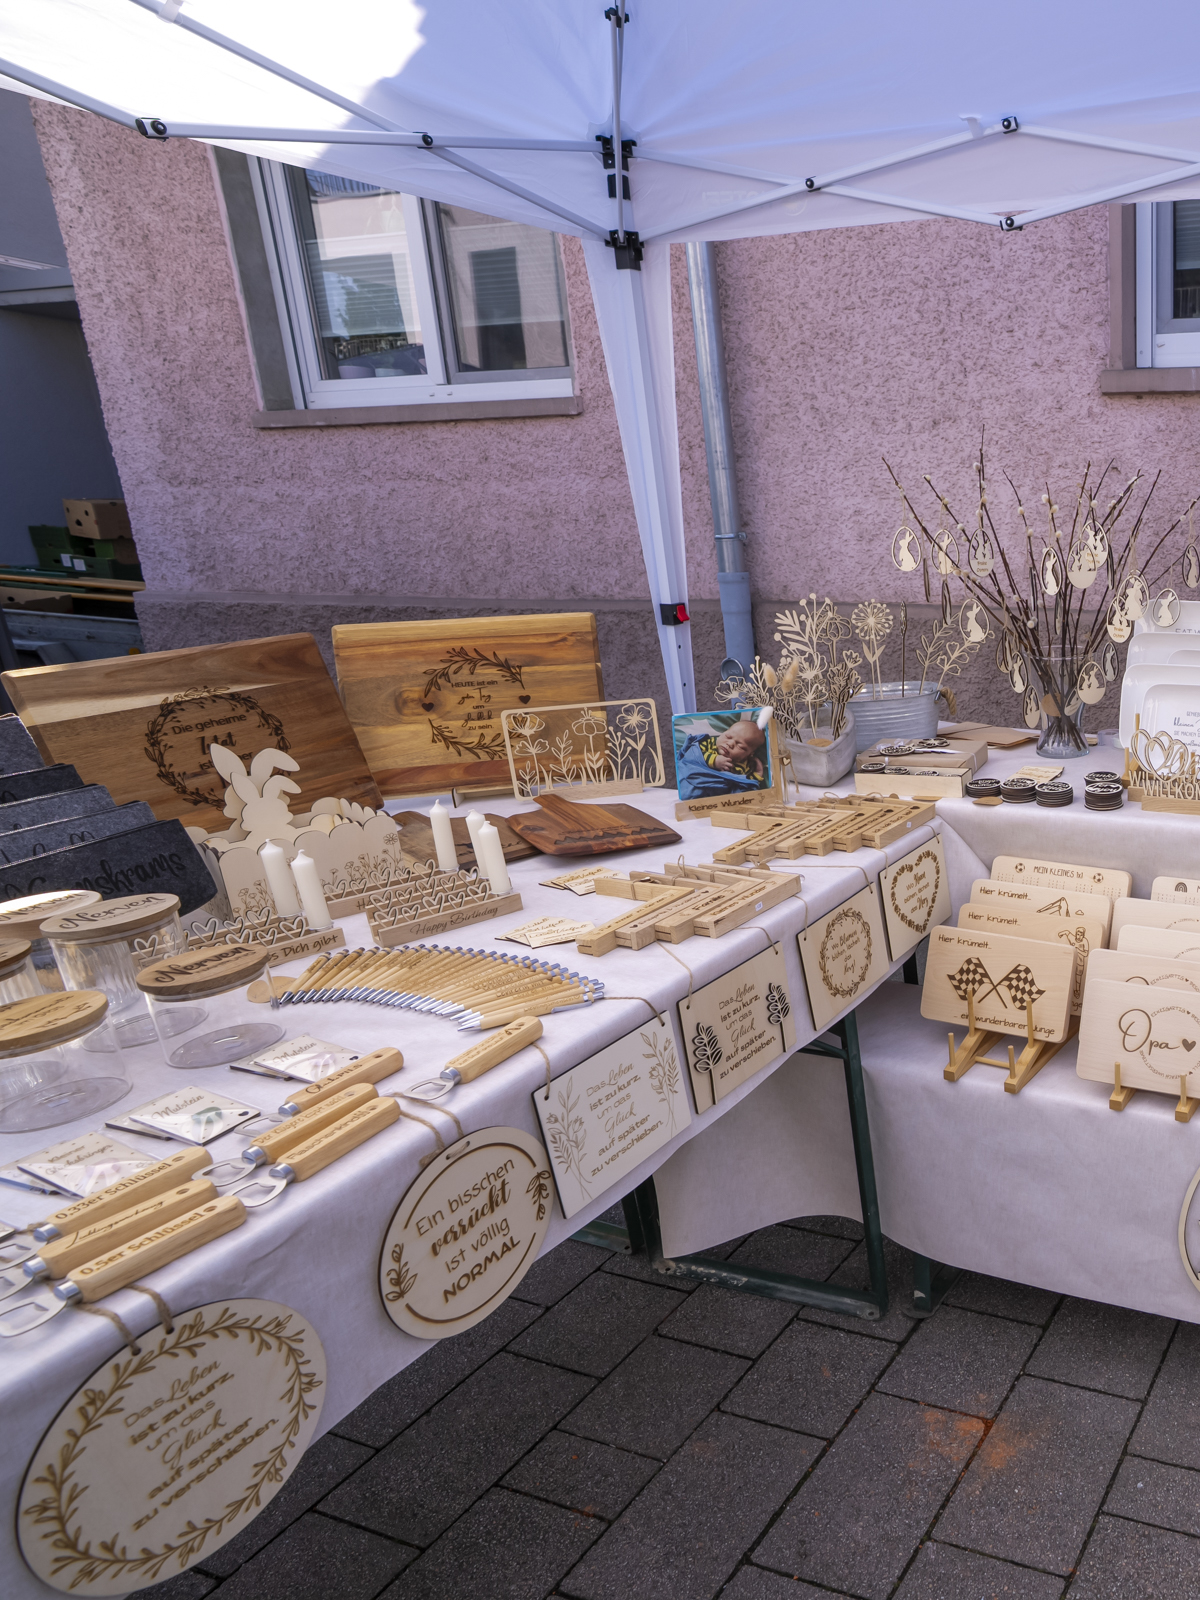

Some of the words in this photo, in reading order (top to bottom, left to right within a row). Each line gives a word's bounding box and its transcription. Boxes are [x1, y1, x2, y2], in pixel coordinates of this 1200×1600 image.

[451, 681, 476, 689] HEUTE
[171, 723, 194, 736] Die
[195, 712, 248, 733] geheime
[688, 801, 718, 812] Kleines
[720, 796, 755, 809] Wunder
[1033, 866, 1049, 875] MEIN
[1050, 868, 1075, 879] KLEINES
[979, 886, 995, 897] Hier
[58, 895, 167, 931] Nerven
[410, 918, 450, 936] Happy
[450, 906, 499, 925] Birthday
[968, 911, 984, 921] Hier
[280, 943, 309, 958] Dich
[312, 934, 339, 953] gibt
[938, 934, 955, 944] Hier
[154, 946, 257, 984] Nerven
[718, 997, 734, 1011] Das
[733, 983, 756, 1004] Leben
[720, 1011, 732, 1023] ist
[732, 1004, 742, 1016] zu
[725, 1017, 739, 1031] um
[739, 1009, 753, 1023] das
[730, 1017, 757, 1048] Glück
[975, 1014, 1028, 1031] wunderbarer
[1033, 1023, 1056, 1036] Junge
[1118, 1008, 1181, 1056] Opa
[719, 1068, 730, 1080] zu
[729, 1035, 777, 1073] verschieben.
[725, 1046, 740, 1063] auf
[740, 1029, 767, 1053] später
[586, 1081, 608, 1097] Das
[606, 1062, 635, 1087] Leben
[151, 1094, 205, 1120] Mutstein
[589, 1097, 604, 1112] ist
[604, 1089, 618, 1102] zu
[597, 1103, 613, 1120] um
[613, 1092, 632, 1107] das
[598, 1137, 617, 1157] auf
[617, 1113, 651, 1143] später
[604, 1101, 637, 1139] Glück
[254, 1133, 272, 1146] Der
[590, 1162, 604, 1177] zu
[604, 1119, 664, 1167] verschieben.
[104, 1162, 172, 1197] Schlüssel
[415, 1208, 446, 1237] Ein
[447, 1158, 516, 1214] bisschen
[127, 1212, 205, 1253] Schlüssel
[430, 1178, 512, 1257] verrückt
[444, 1247, 467, 1274] ist
[470, 1217, 511, 1252] völlig
[442, 1235, 522, 1304] NORMAL
[123, 1397, 166, 1428] Das
[164, 1359, 222, 1402] Leben
[130, 1421, 159, 1446] ist
[161, 1406, 188, 1425] zu
[187, 1371, 236, 1410] kurz,
[146, 1427, 178, 1452] um
[180, 1400, 216, 1427] das
[161, 1408, 228, 1471] Glück
[132, 1507, 159, 1532] zu
[160, 1418, 280, 1508] verschieben.
[147, 1465, 186, 1499] auf
[186, 1417, 253, 1471] später
